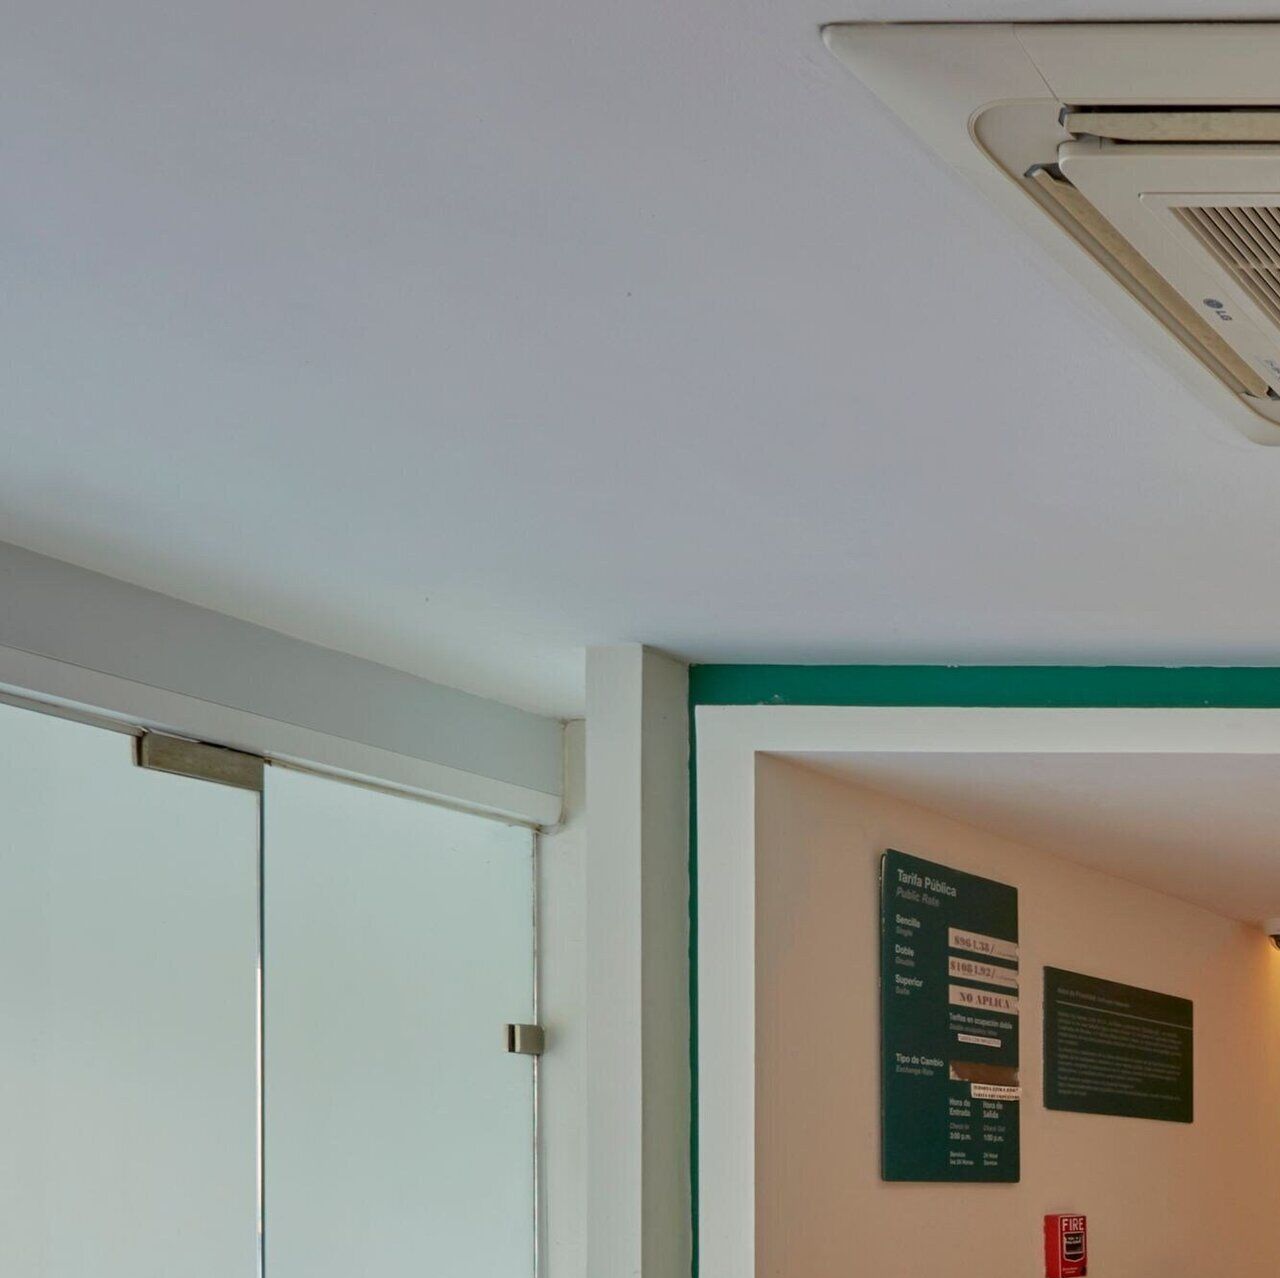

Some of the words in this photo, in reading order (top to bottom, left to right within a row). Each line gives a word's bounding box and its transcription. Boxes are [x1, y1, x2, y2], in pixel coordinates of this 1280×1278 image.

[897, 868, 922, 888] Tarifa
[924, 876, 957, 897] Pública
[1062, 1217, 1084, 1231] FIRE
